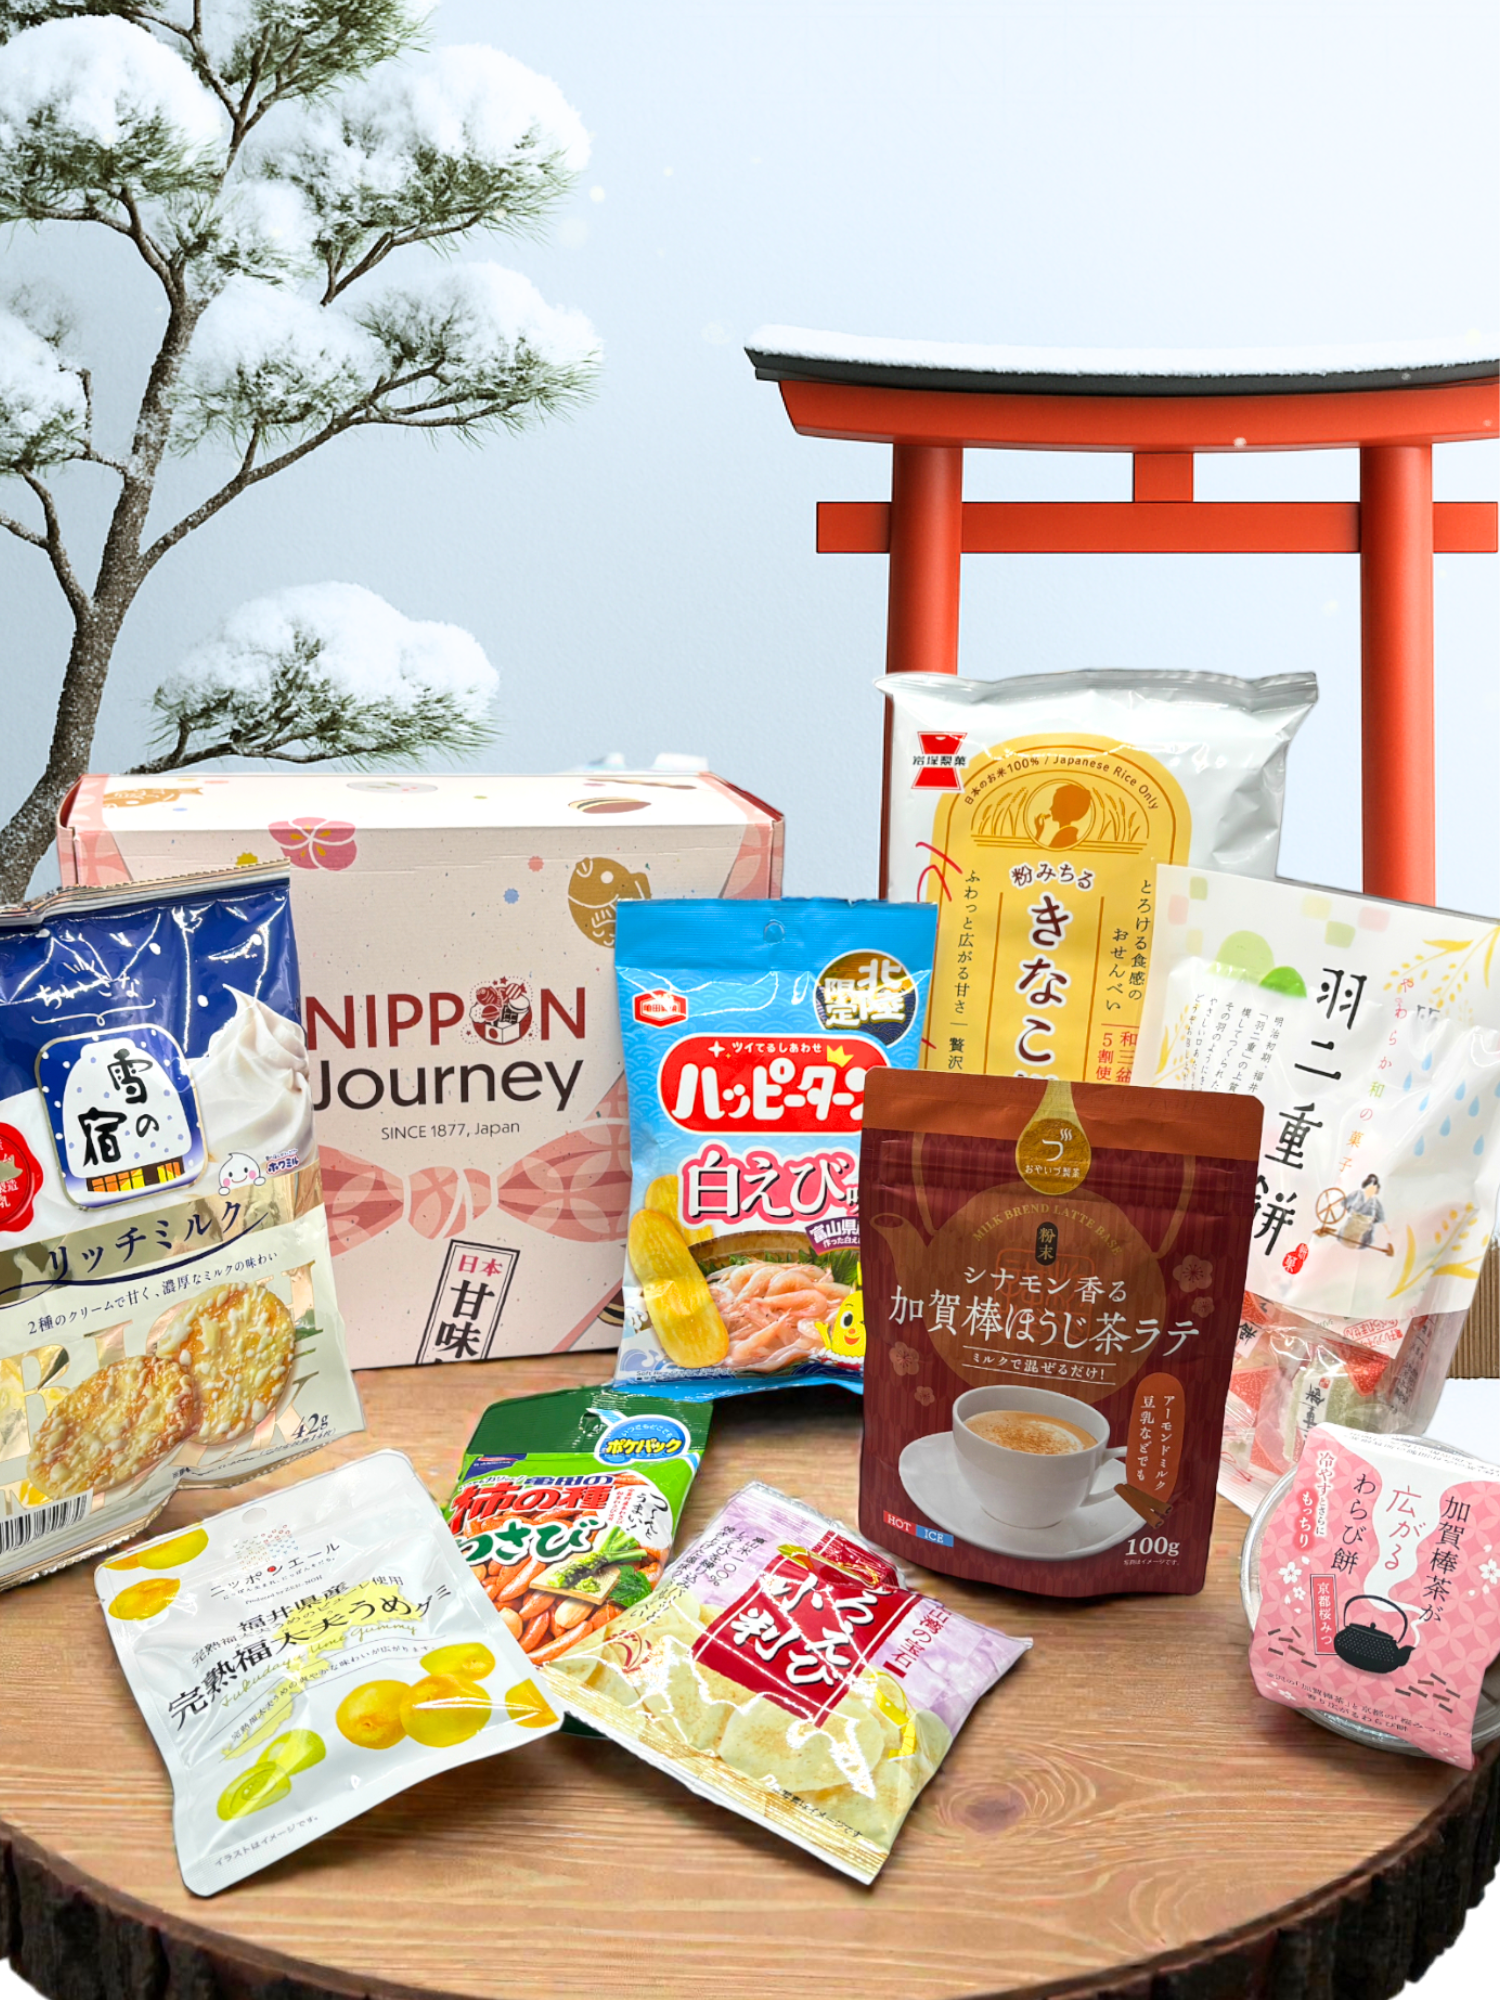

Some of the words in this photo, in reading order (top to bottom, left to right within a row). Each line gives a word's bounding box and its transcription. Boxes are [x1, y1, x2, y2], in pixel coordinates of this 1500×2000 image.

[912, 756, 967, 767] 岩塚製菓
[1052, 756, 1110, 773] Japanese
[1112, 765, 1137, 788] Rice
[1138, 784, 1160, 811] Only
[1012, 863, 1095, 890] 粉みちる
[1128, 879, 1152, 1001] とろける食感の
[858, 958, 905, 1021] 北陸
[1014, 894, 1070, 1079] きなこ
[1105, 927, 1129, 1012] おせんべい
[825, 977, 861, 1028] 限定
[731, 1041, 823, 1054] ツイてるしあわせ
[77, 1048, 160, 1167] 雪の宿
[313, 1059, 585, 1112] Journey
[1250, 967, 1368, 1257] 羽二重餅
[381, 1125, 428, 1140] SINCE
[431, 1122, 471, 1138] 1877,
[474, 1120, 521, 1139] Japan
[1024, 1163, 1081, 1179] おやいづ製茶
[48, 1200, 242, 1280] リッチミルク
[809, 1219, 860, 1244] 富山県
[971, 1213, 1004, 1244] MILK
[1004, 1202, 1051, 1221] BREND
[1052, 1204, 1096, 1229] LATTE
[1095, 1225, 1123, 1257] BASE
[1037, 1226, 1056, 1261] 粉末
[27, 1251, 279, 1336] 2種のクリームで甘く、濃厚なミルクの味わい
[457, 1253, 504, 1278] 日本
[963, 1265, 1127, 1305] シナモン香る
[433, 1279, 496, 1362] 甘味
[888, 1284, 1201, 1358] 加賀棒ほうじ茶ラテ
[291, 1412, 330, 1440] 42g
[606, 1437, 683, 1455] ポケパック
[1135, 1395, 1157, 1482] 豆乳などでも
[1153, 1394, 1176, 1492] アーモンドミルク
[451, 1480, 615, 1536] 柿の種
[1299, 1490, 1314, 1549] もっちり
[1315, 1452, 1335, 1536] 冷やすとさらに
[886, 1513, 913, 1533] HOT
[923, 1528, 945, 1544] ICE
[1126, 1536, 1181, 1558] 100g
[1330, 1473, 1377, 1575] わらび餅
[1384, 1485, 1427, 1571] 広がる
[210, 1542, 341, 1598] ニッポンエール
[1418, 1495, 1472, 1623] 加賀棒茶が
[1316, 1581, 1334, 1646] 京都桜みつ
